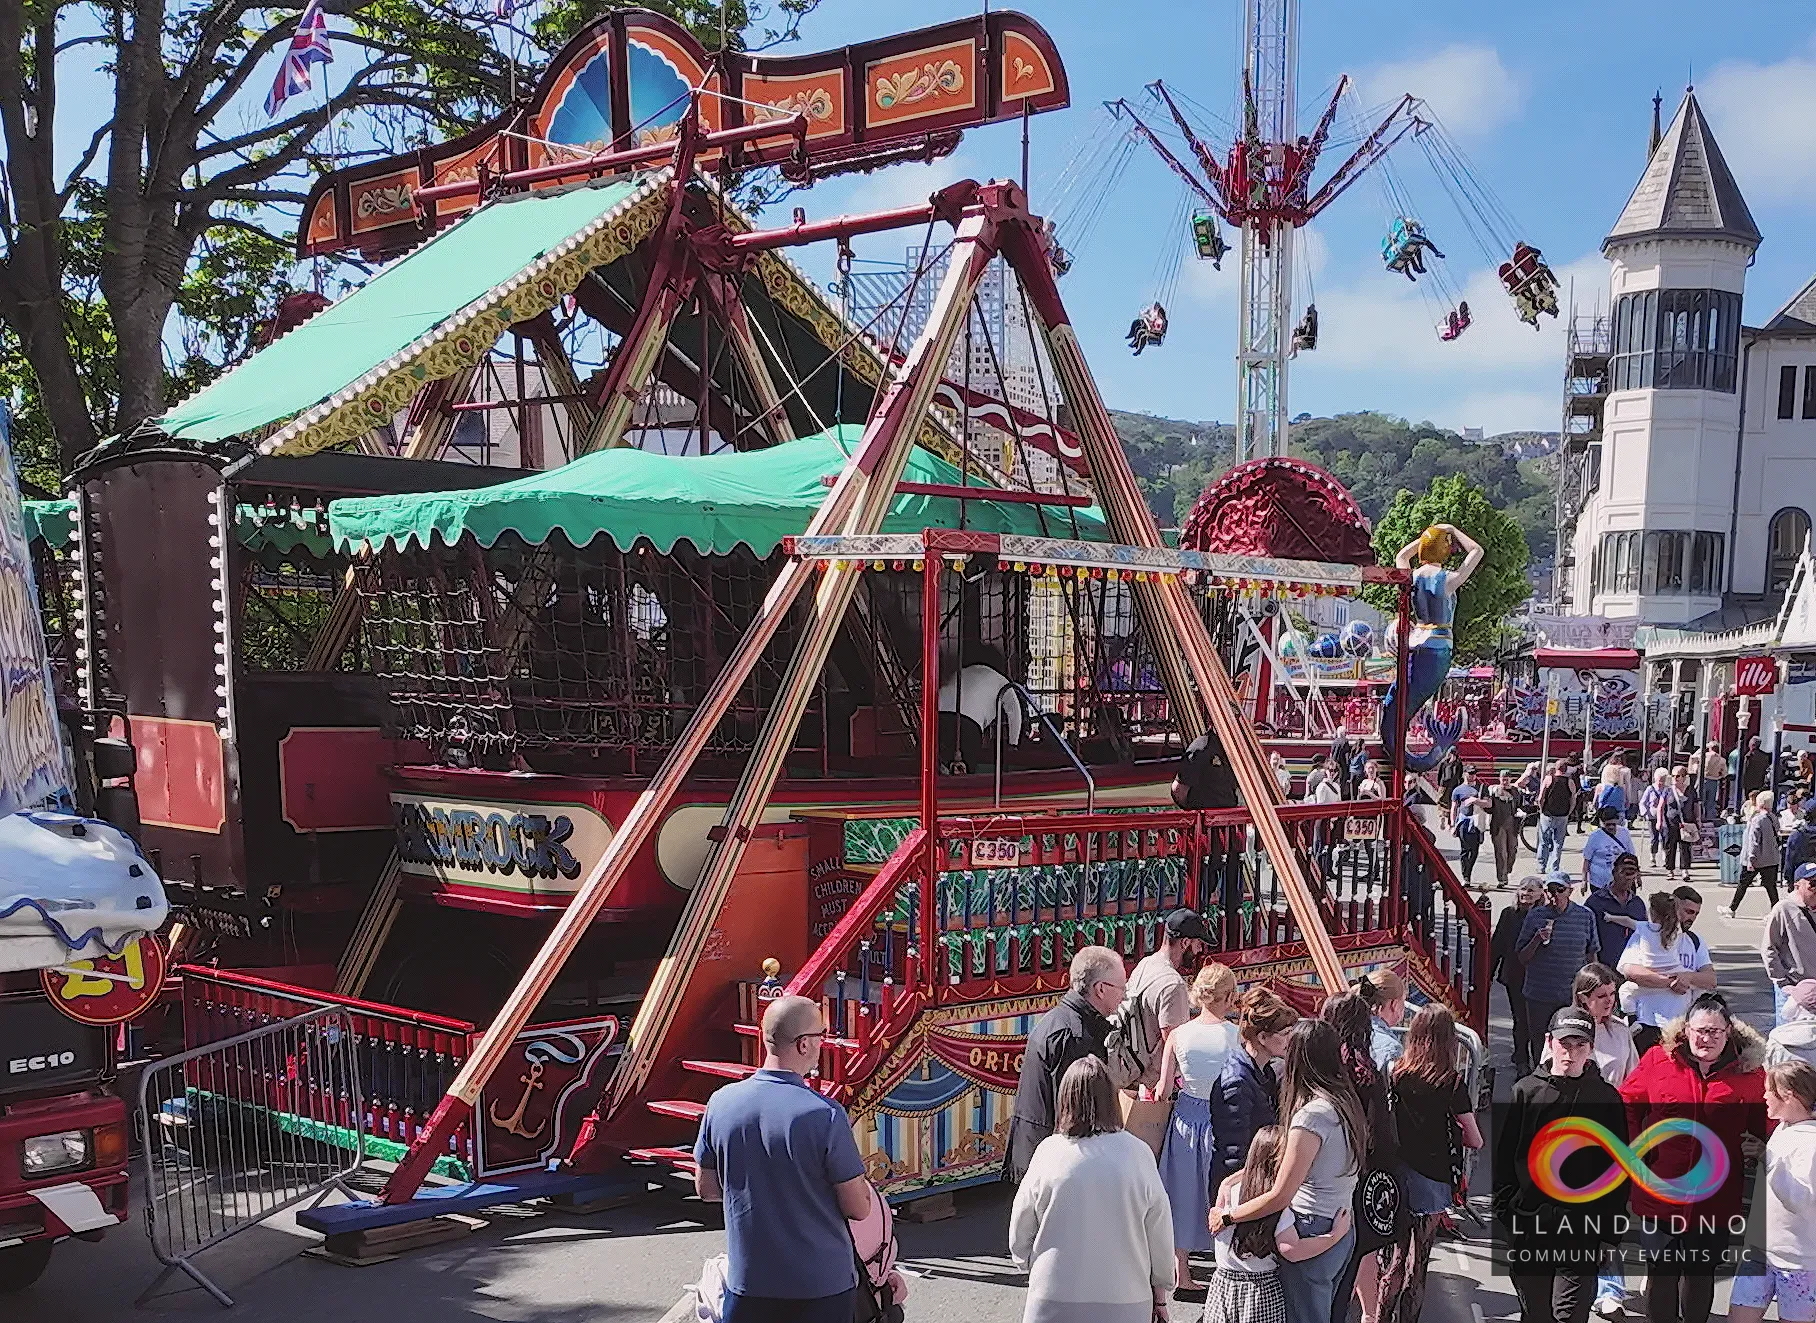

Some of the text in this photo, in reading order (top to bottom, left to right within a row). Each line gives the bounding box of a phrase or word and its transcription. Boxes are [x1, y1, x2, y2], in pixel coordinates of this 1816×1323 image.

[1739, 662, 1773, 692] illy
[810, 856, 842, 881] SMALL
[814, 879, 862, 899] CHILDREN
[820, 898, 848, 919] MUST
[9, 1051, 75, 1074] EC10
